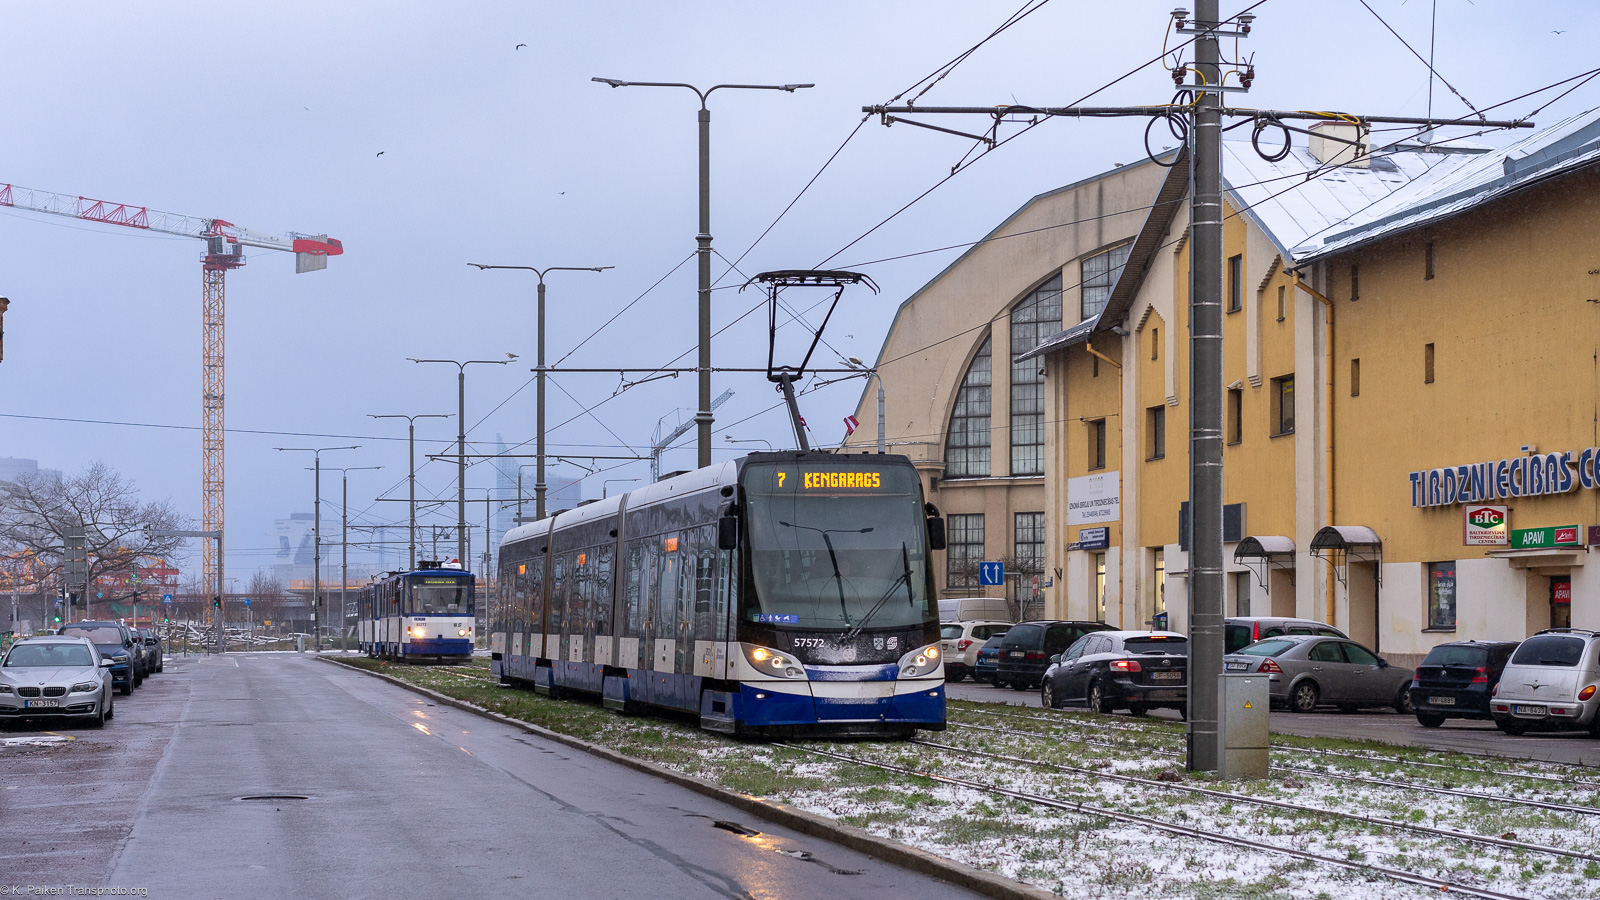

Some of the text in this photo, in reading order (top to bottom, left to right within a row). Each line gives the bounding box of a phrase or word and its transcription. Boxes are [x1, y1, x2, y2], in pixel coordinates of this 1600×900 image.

[777, 472, 787, 488] 7
[1409, 445, 1574, 508] TIRDZNIECĪBAS
[1475, 510, 1499, 524] BTC
[1522, 531, 1545, 545] APAVI
[1555, 589, 1570, 599] APAVI
[794, 638, 825, 648] 57572
